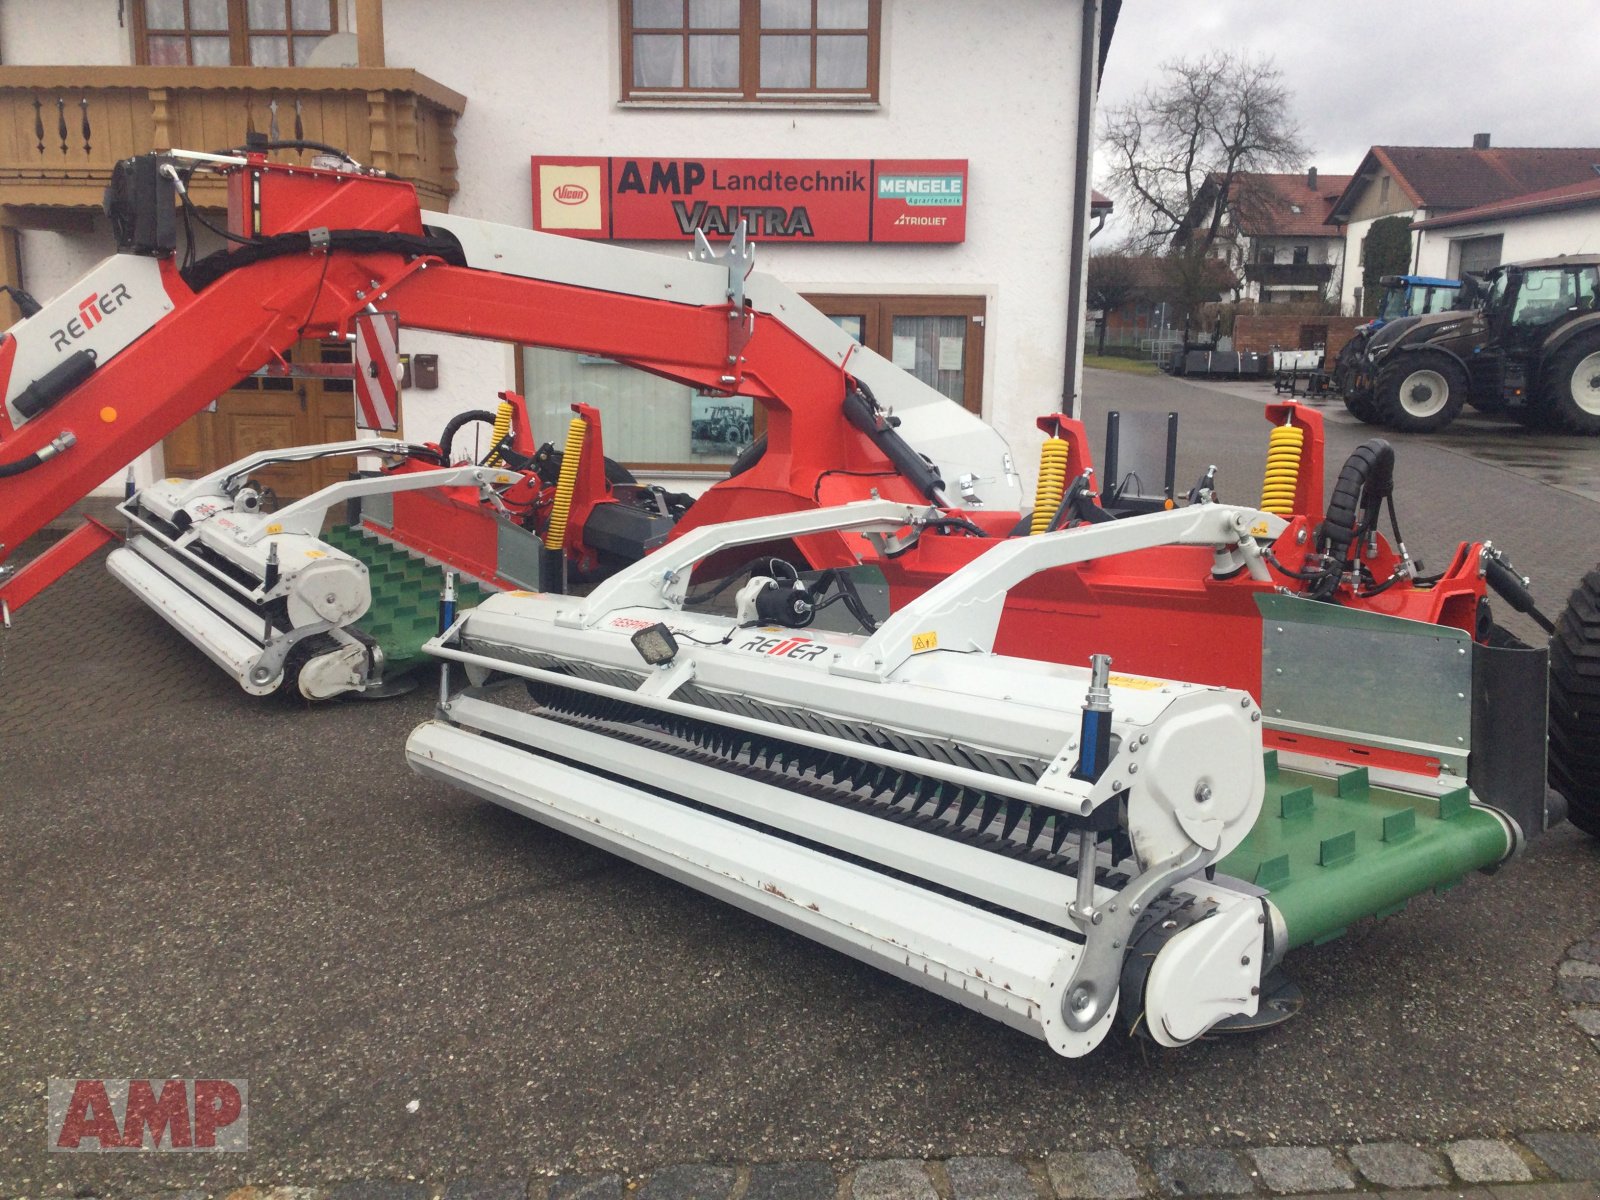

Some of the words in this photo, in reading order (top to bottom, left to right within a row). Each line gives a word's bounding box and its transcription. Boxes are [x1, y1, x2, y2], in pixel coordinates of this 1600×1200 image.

[617, 161, 705, 194] AMP
[712, 169, 865, 191] Landtechnik
[558, 186, 585, 200] Vicon
[880, 179, 961, 193] MENGELE
[908, 197, 961, 206] Agrartechnik
[904, 216, 947, 226] TRIOLIET
